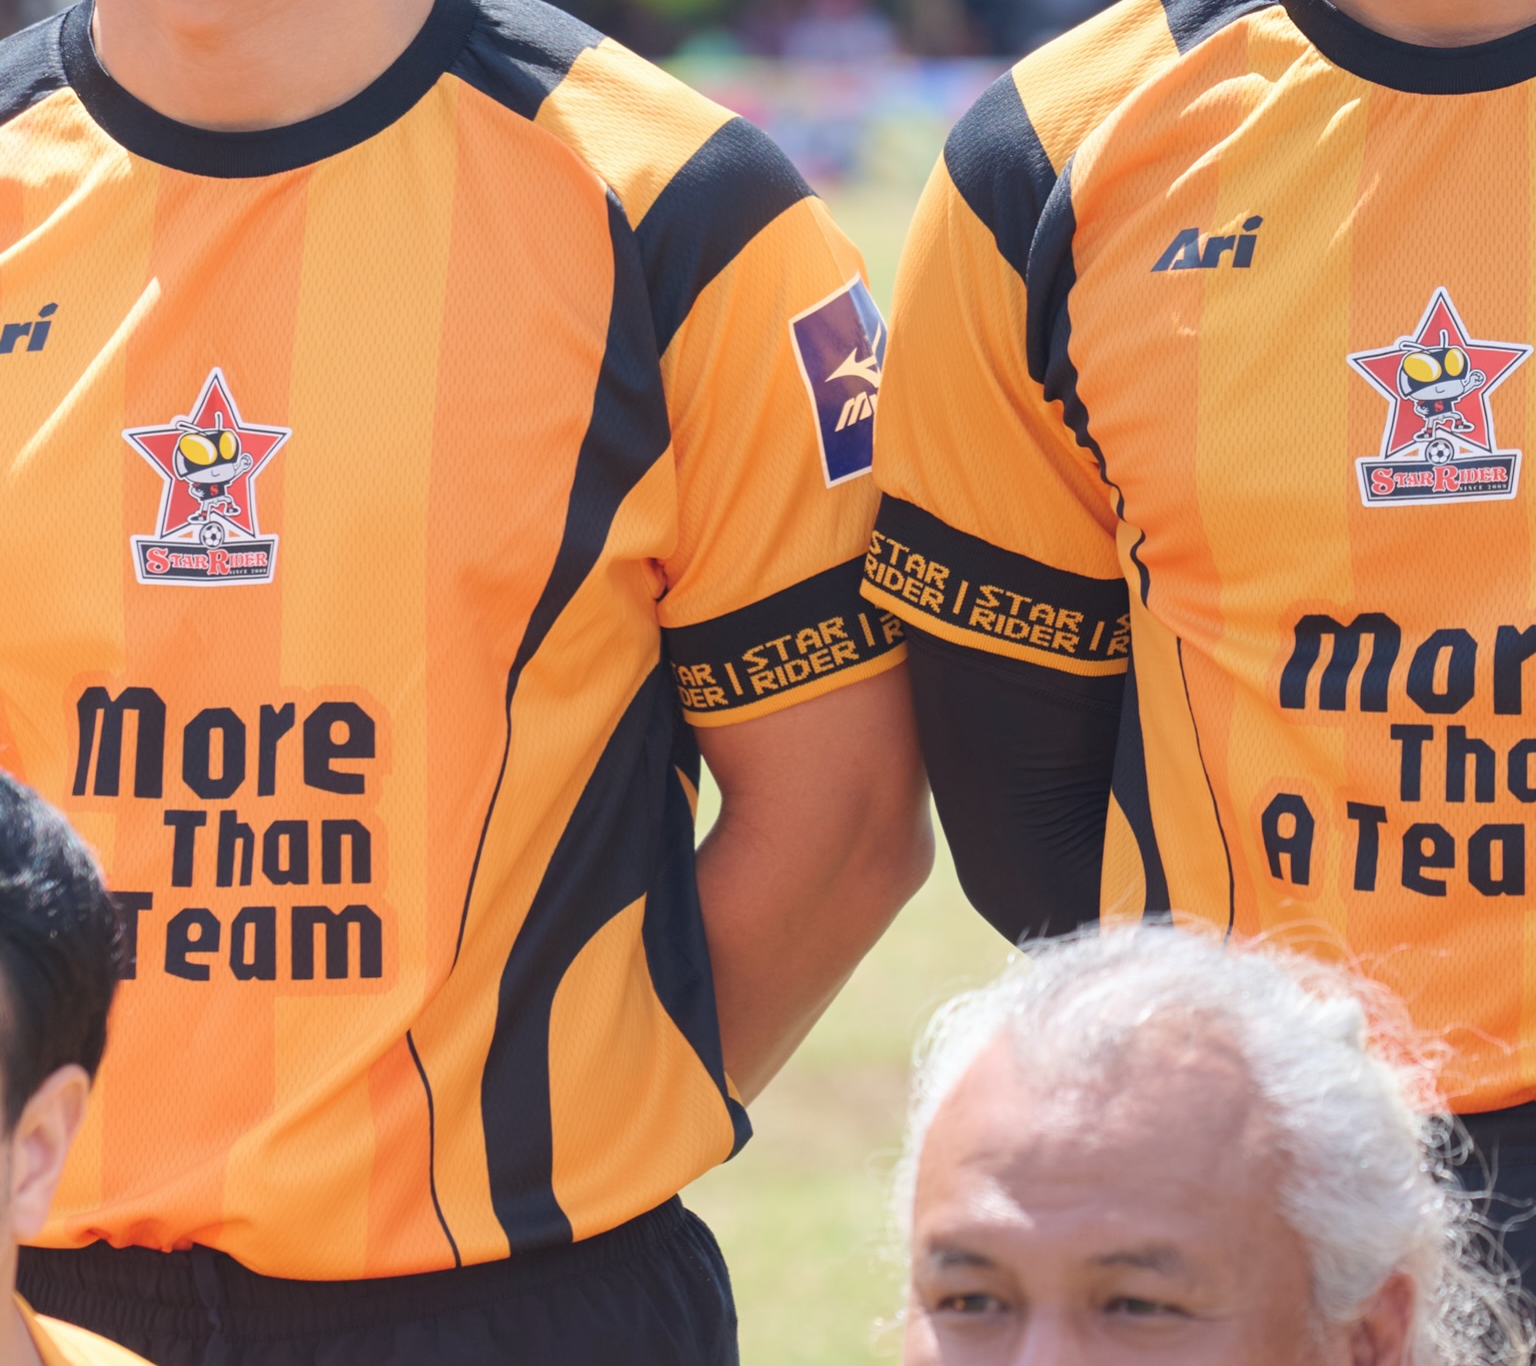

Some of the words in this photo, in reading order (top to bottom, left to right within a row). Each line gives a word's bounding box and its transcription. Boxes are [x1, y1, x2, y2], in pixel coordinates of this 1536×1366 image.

[1151, 216, 1264, 273] Ari
[0, 303, 58, 354] ri
[864, 553, 945, 613] RIDER
[869, 530, 950, 589] STAR
[969, 606, 1080, 653] RIDER
[975, 585, 1084, 633] STAR
[742, 616, 848, 674] STAR
[750, 640, 859, 695] RIDER
[678, 663, 717, 686] AR
[678, 686, 729, 708] DER
[73, 687, 375, 800] More
[165, 810, 371, 887] Than
[1262, 793, 1315, 886] A
